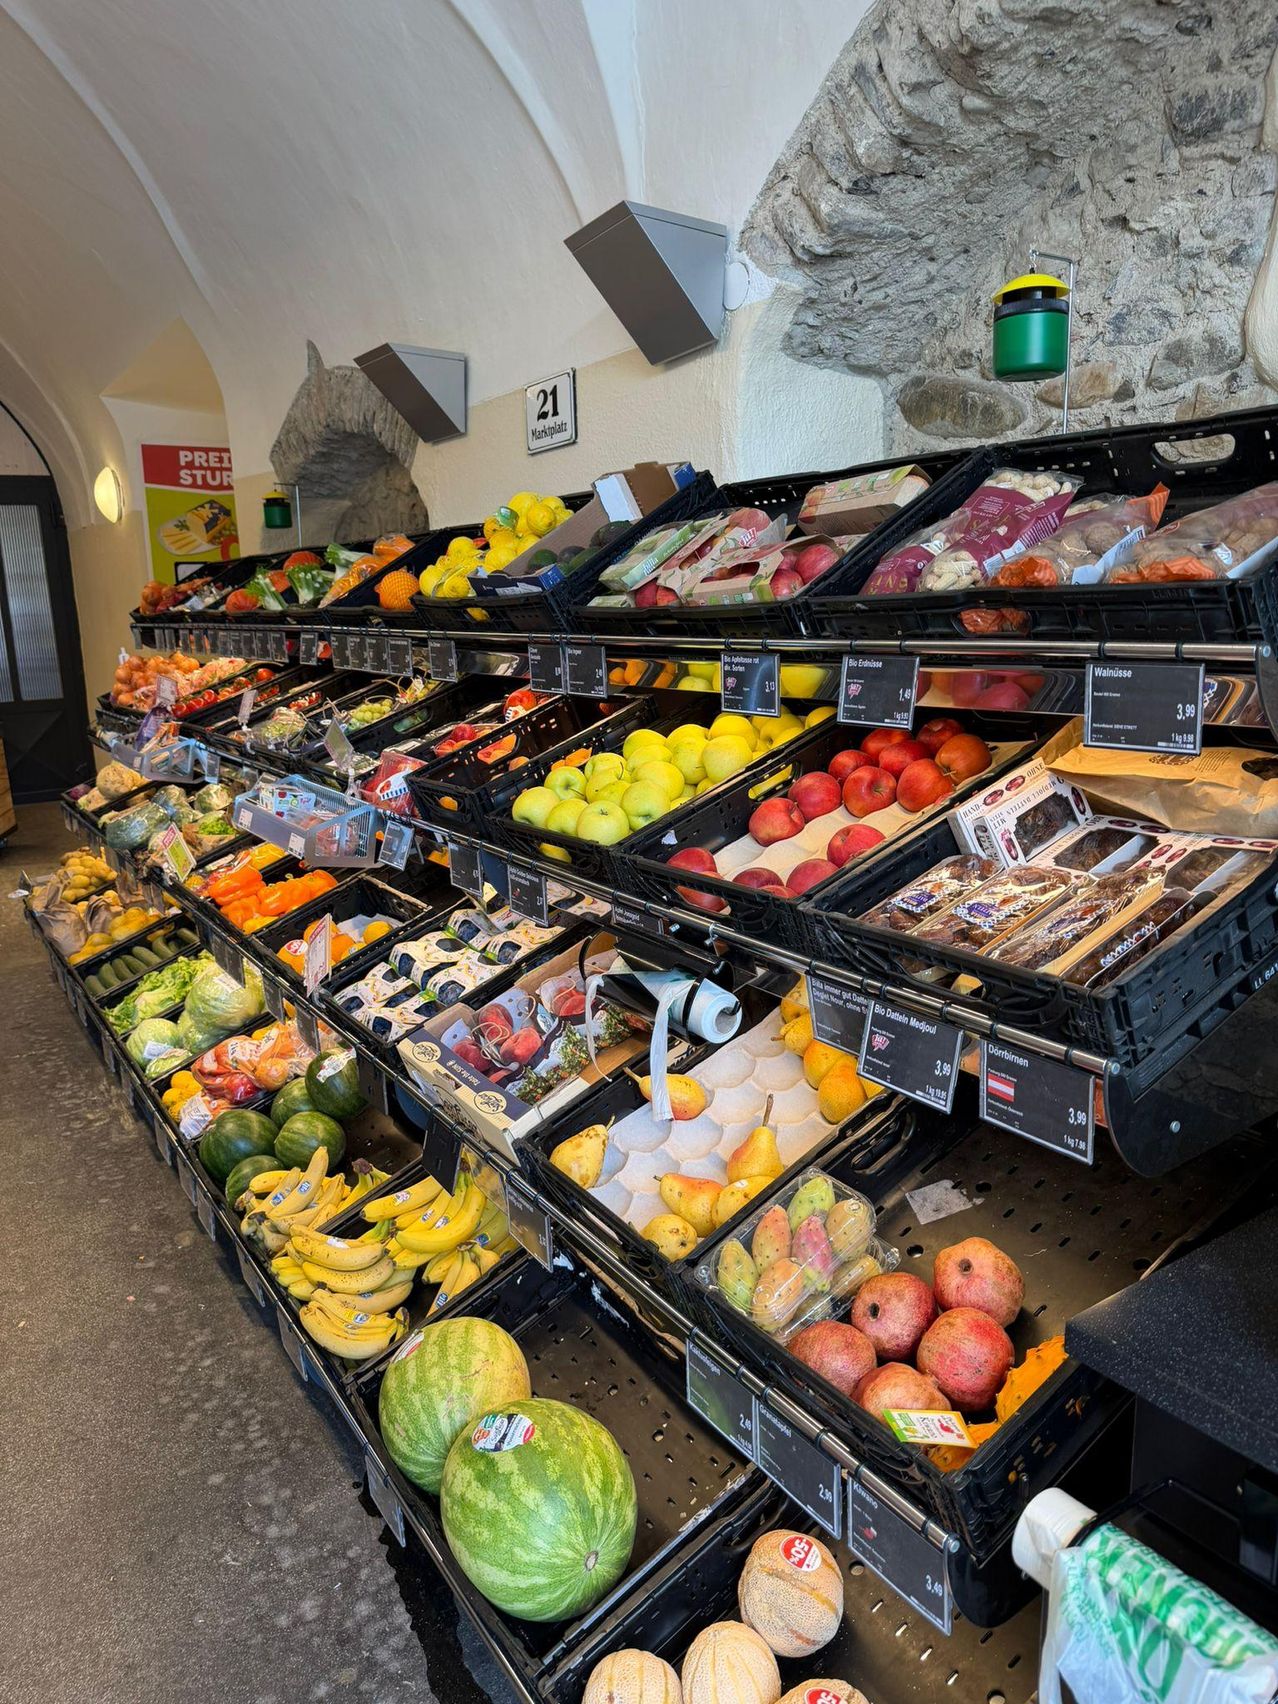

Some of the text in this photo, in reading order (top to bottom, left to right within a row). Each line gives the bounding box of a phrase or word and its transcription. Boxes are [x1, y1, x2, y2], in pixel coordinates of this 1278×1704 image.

[536, 384, 559, 422] 21
[531, 420, 568, 442] Marktplatz
[178, 450, 231, 468] PREI
[848, 658, 883, 669] Bio Erdnüsse
[1094, 666, 1133, 678] Walnüsse
[1175, 733, 1183, 744] kg
[823, 980, 841, 996] immer
[841, 992, 852, 1000] gut
[846, 1001, 861, 1013] ohne
[874, 1004, 885, 1015] Bio
[886, 1008, 908, 1026] Datteln
[909, 1017, 937, 1035] Medjoul
[988, 1043, 1029, 1068] Dörrbirnen
[1067, 1136, 1075, 1147] kg
[759, 1404, 792, 1438] Granatapfel
[852, 1481, 878, 1510] Kiwano
[789, 1538, 811, 1565] -50%
